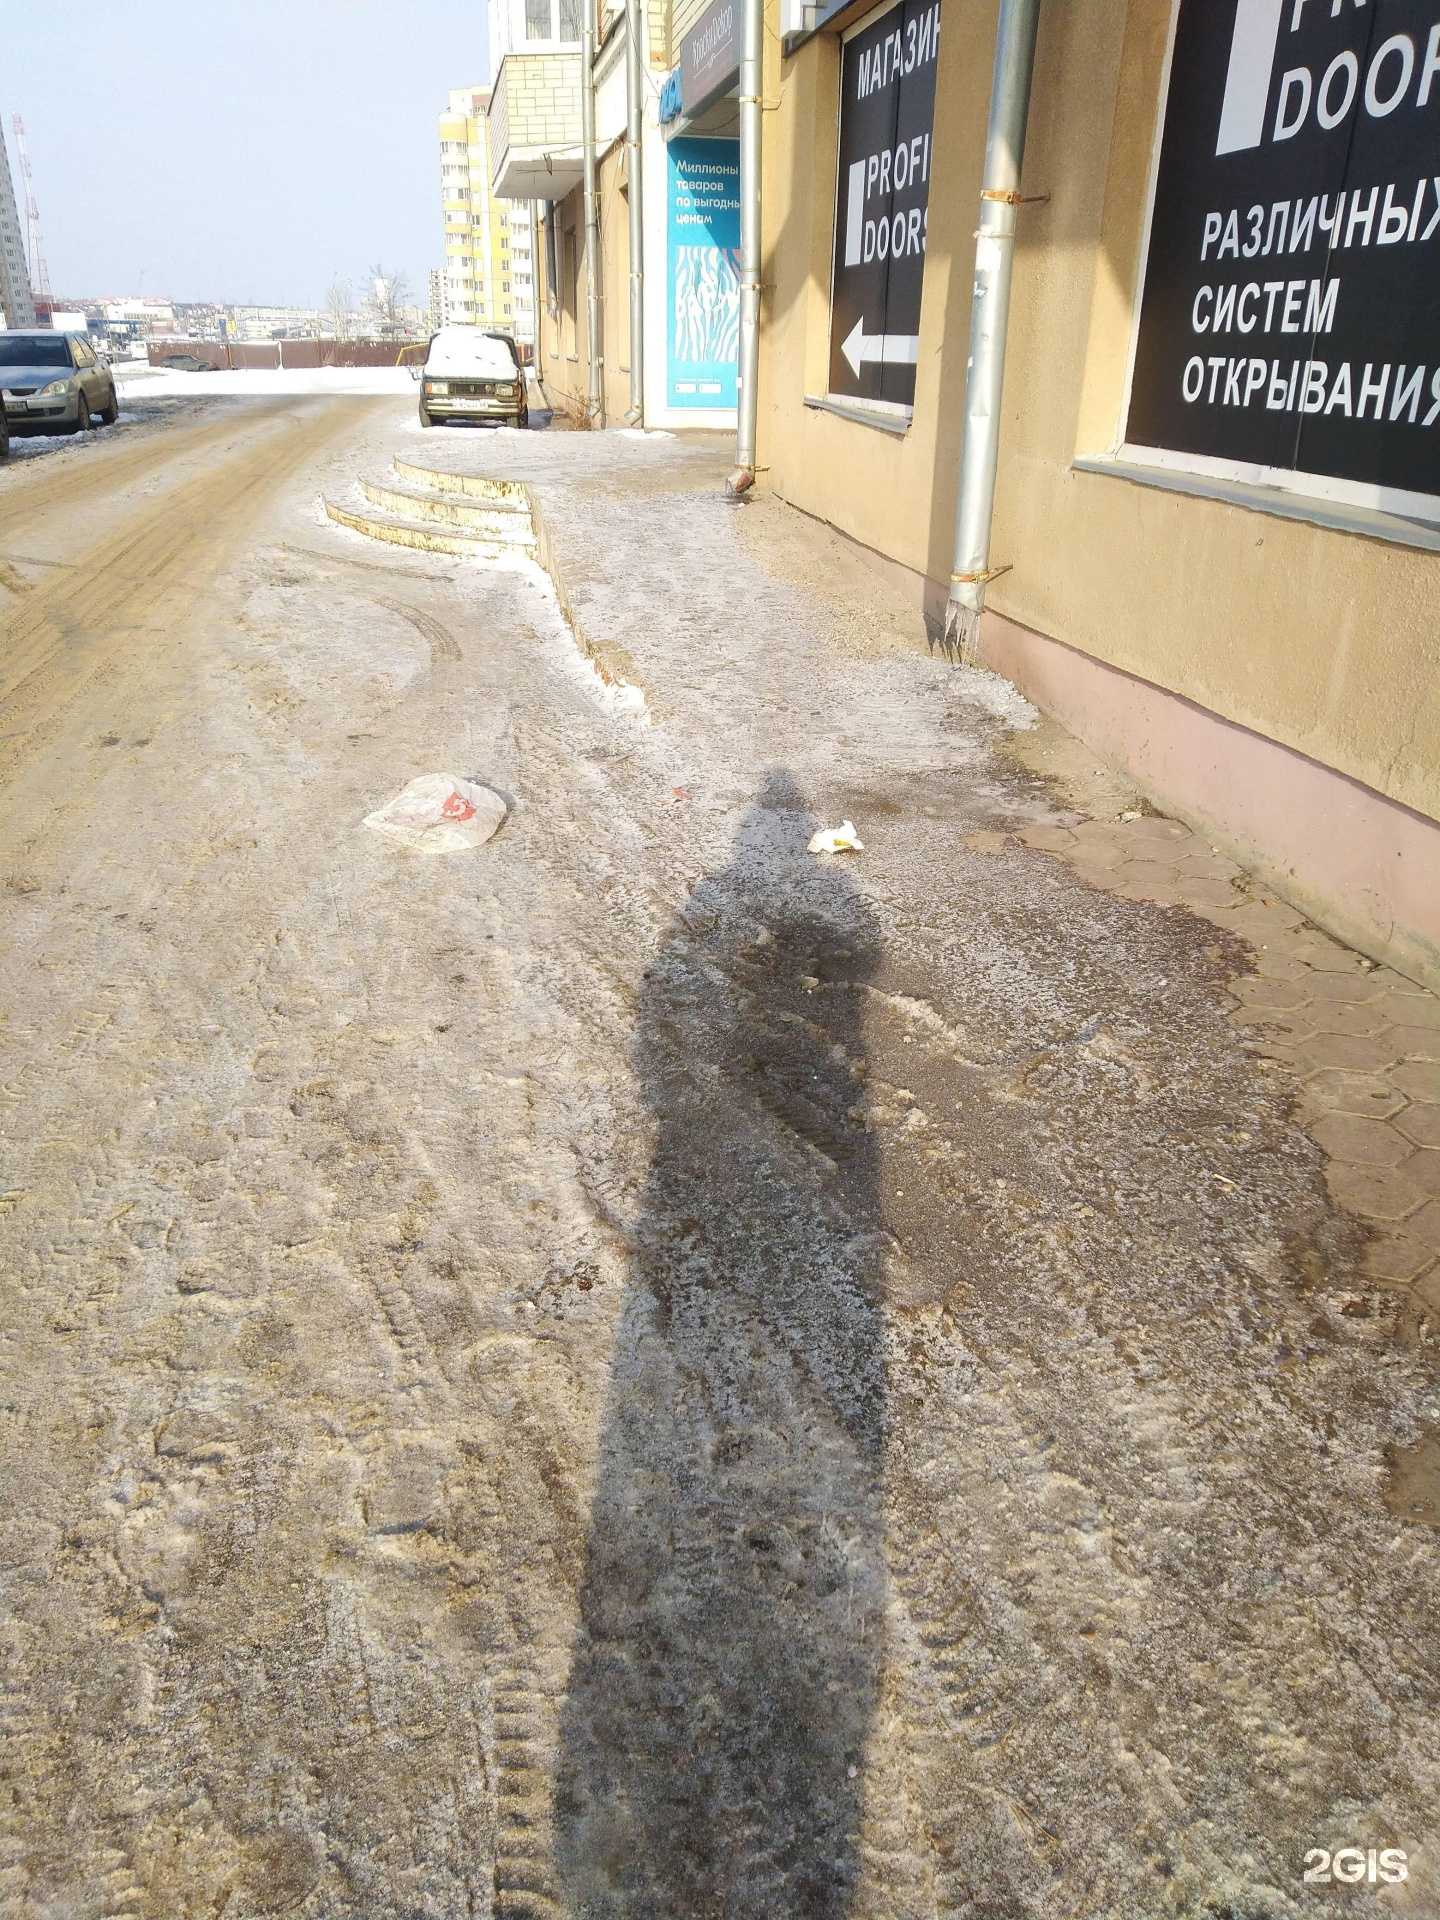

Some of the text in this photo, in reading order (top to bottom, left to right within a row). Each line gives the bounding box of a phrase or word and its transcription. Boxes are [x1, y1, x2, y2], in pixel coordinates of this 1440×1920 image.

[857, 2, 941, 100] МАГАЗИН
[675, 159, 739, 175] Миллионы
[866, 132, 929, 200] PROFI
[676, 180, 725, 193] товаров
[676, 196, 691, 208] по
[676, 213, 713, 225] ценам
[1192, 278, 1340, 333] СИСТЕМ
